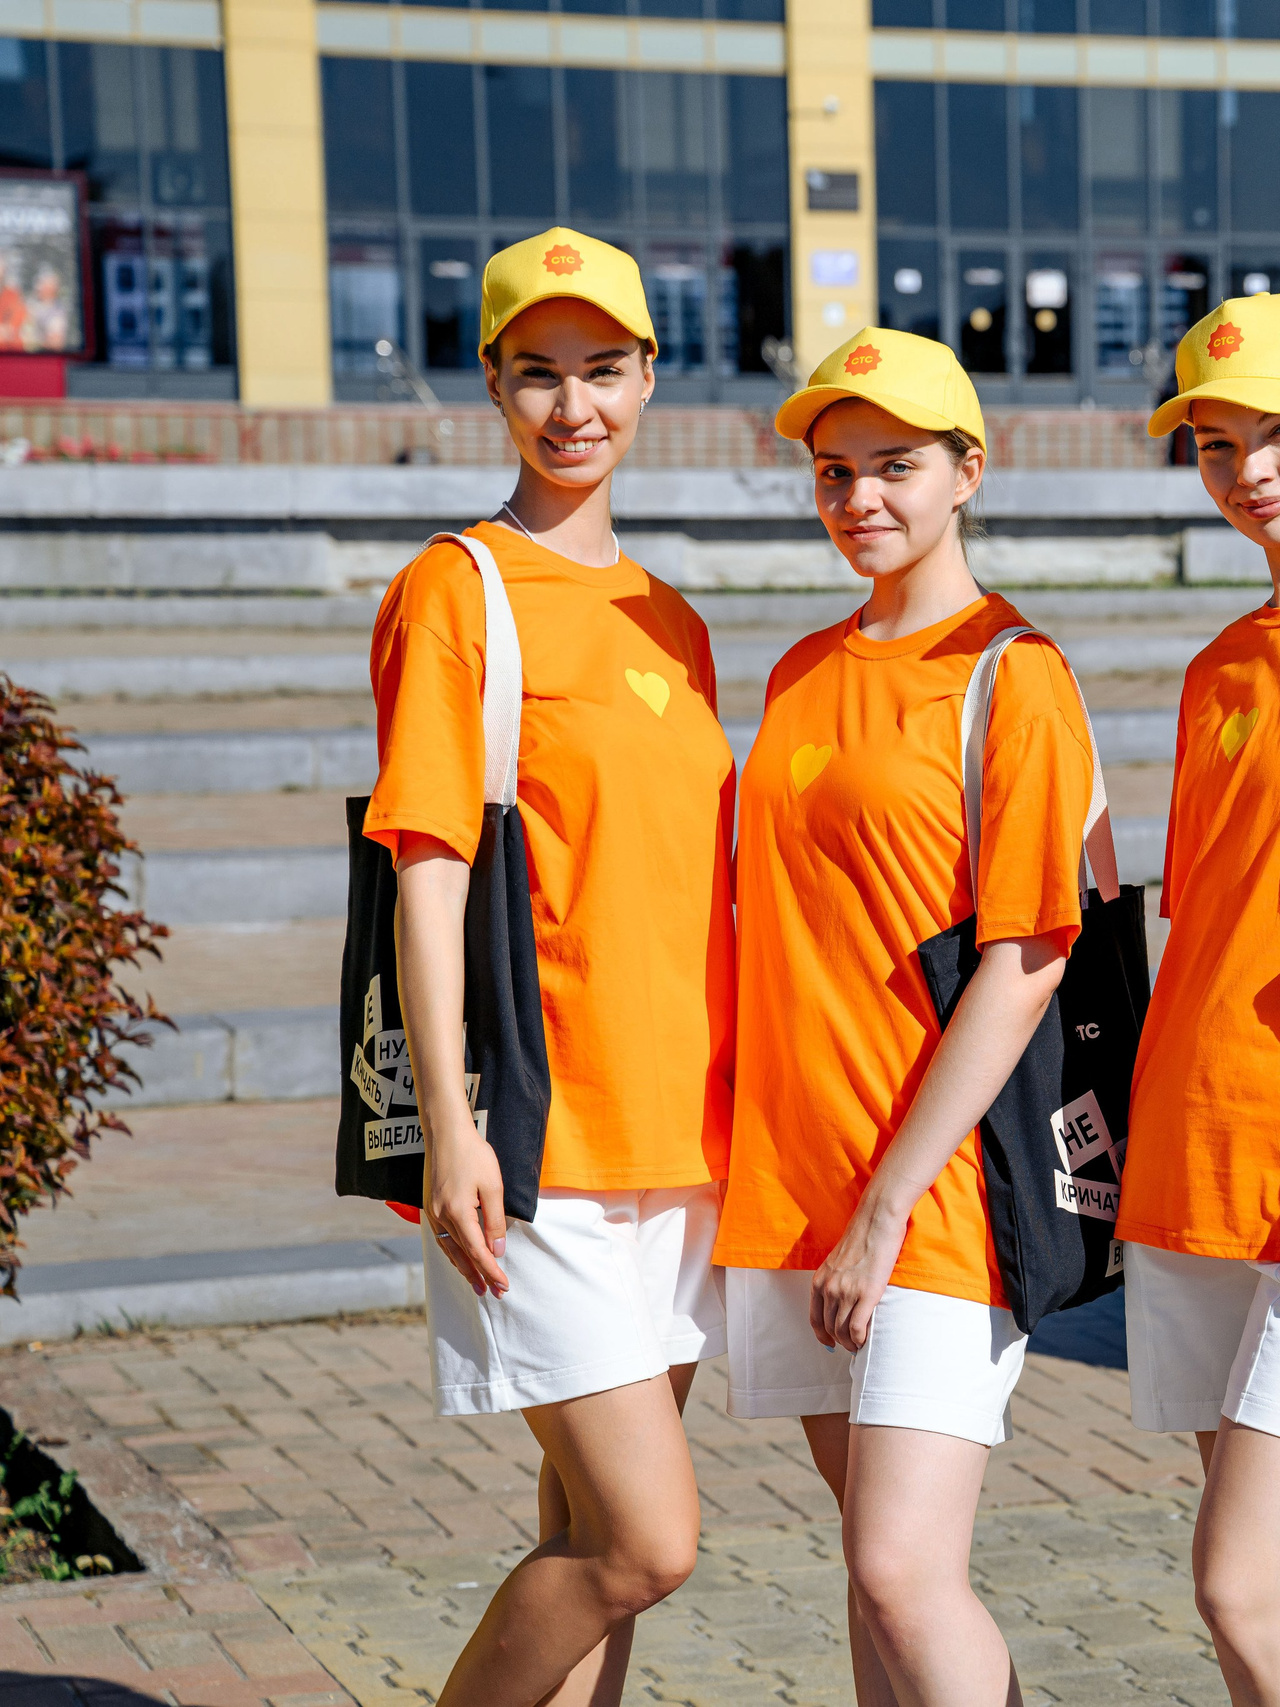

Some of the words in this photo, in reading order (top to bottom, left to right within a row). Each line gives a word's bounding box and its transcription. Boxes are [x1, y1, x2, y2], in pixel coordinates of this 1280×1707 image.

[551, 256, 575, 264] СТС
[1213, 335, 1235, 347] СТС
[851, 355, 873, 365] СТС
[1075, 1023, 1100, 1040] ТС
[1058, 1112, 1099, 1156] НЕ
[1061, 1180, 1120, 1213] КРИЧАТ
